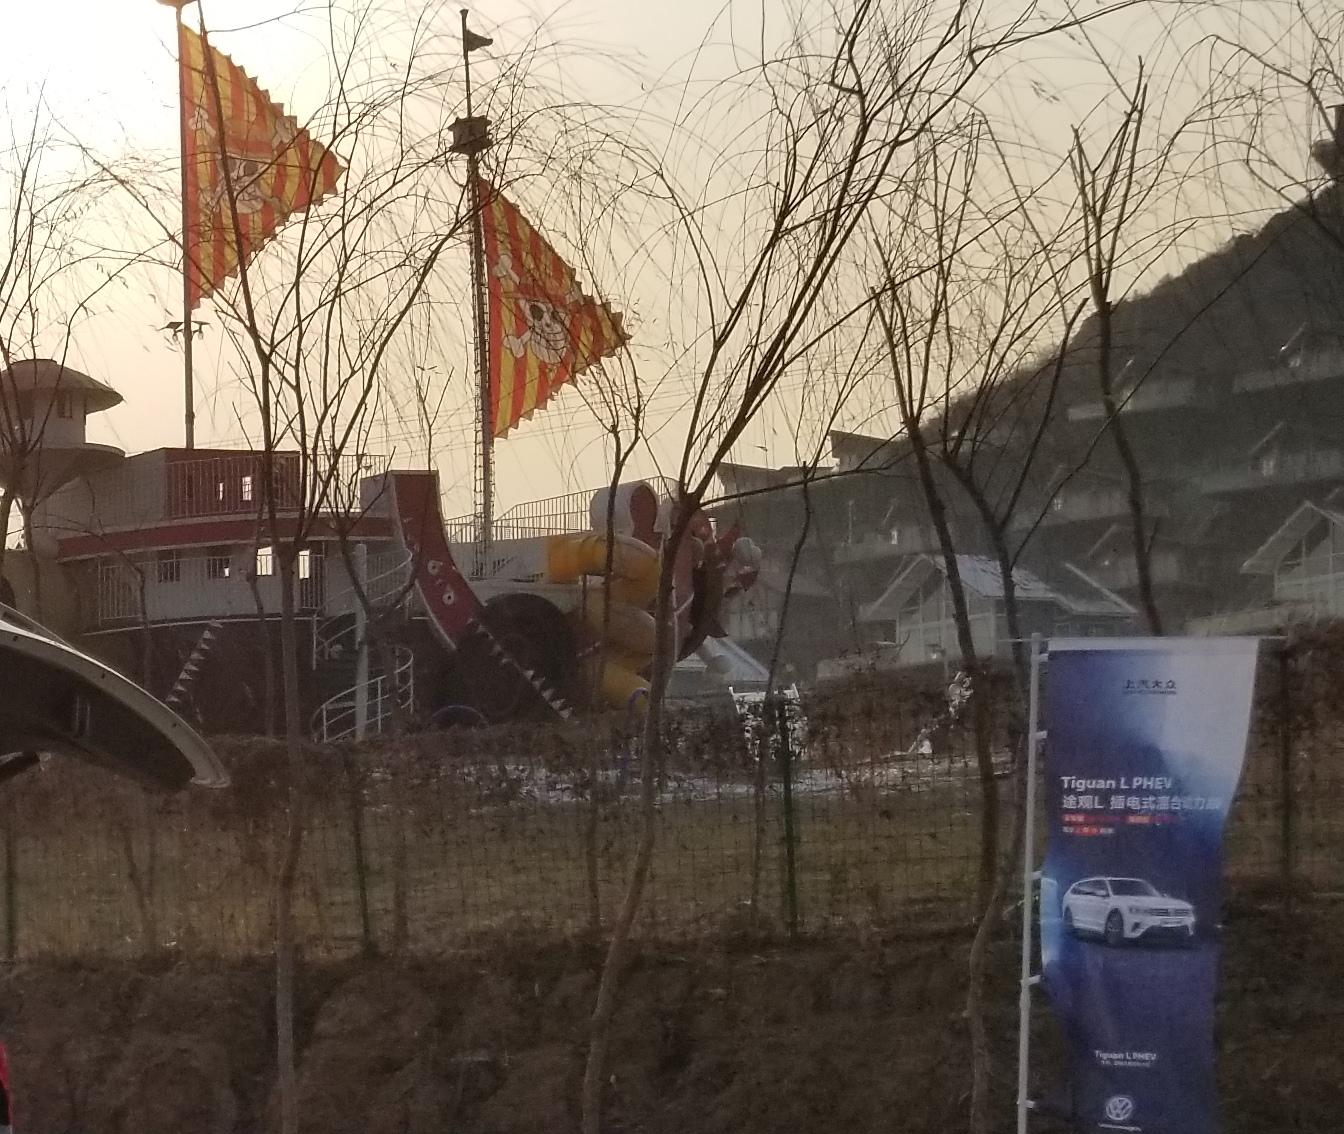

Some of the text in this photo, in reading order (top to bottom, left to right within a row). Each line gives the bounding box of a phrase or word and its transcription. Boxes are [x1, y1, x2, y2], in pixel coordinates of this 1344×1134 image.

[1061, 776, 1172, 791] Tiguan L PHEV
